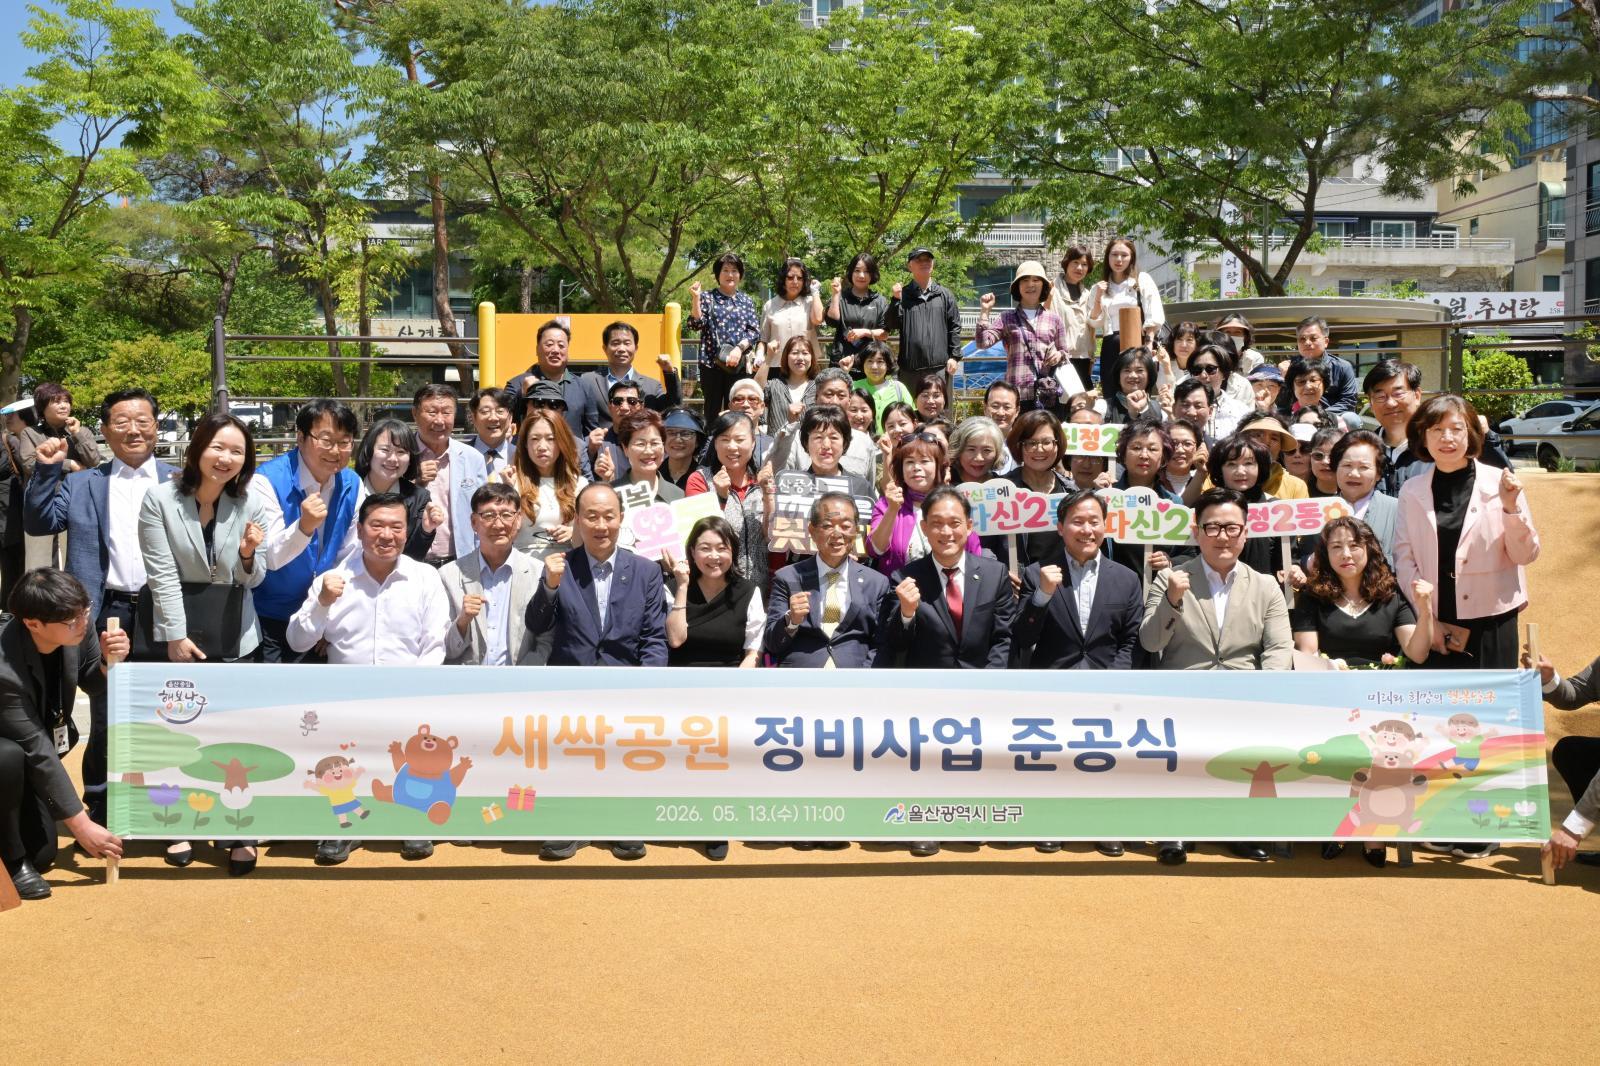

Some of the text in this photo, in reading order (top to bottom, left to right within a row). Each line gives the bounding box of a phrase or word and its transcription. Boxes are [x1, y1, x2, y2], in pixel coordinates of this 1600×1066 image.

[1475, 297, 1541, 320] 추어탕
[1104, 494, 1152, 508] 신곁에
[493, 715, 1177, 772] 새싹공원 정비사업 준공식
[655, 803, 846, 823] 2026. 05. 13.(수) 11:00
[908, 804, 1023, 824] 울산광역시 남구
